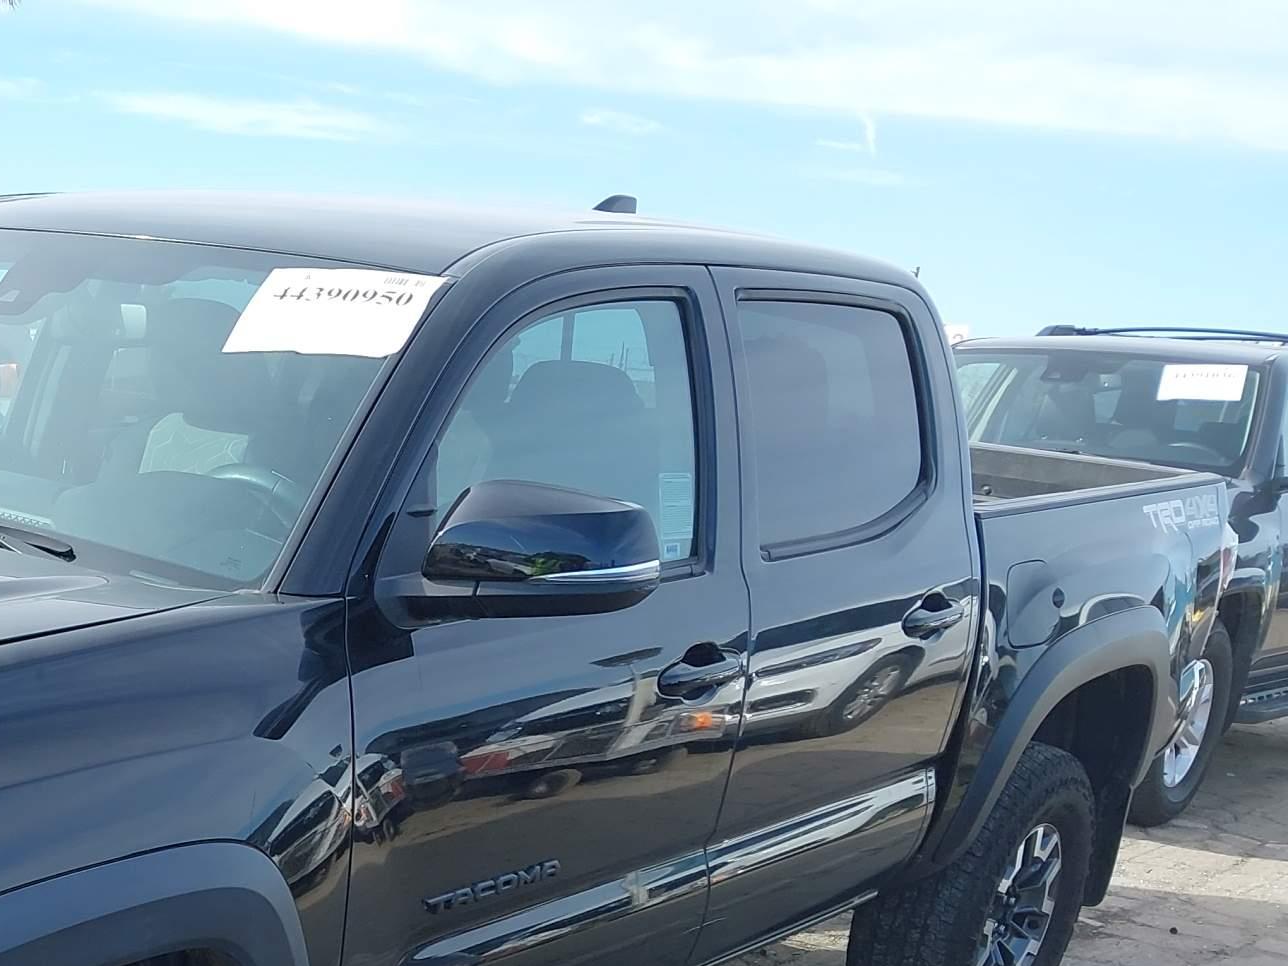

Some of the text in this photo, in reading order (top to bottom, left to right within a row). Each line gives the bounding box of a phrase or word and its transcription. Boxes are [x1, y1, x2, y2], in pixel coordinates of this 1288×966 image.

[272, 286, 413, 306] 44390950
[1142, 499, 1186, 534] TRD
[423, 858, 561, 914] TACOMA
